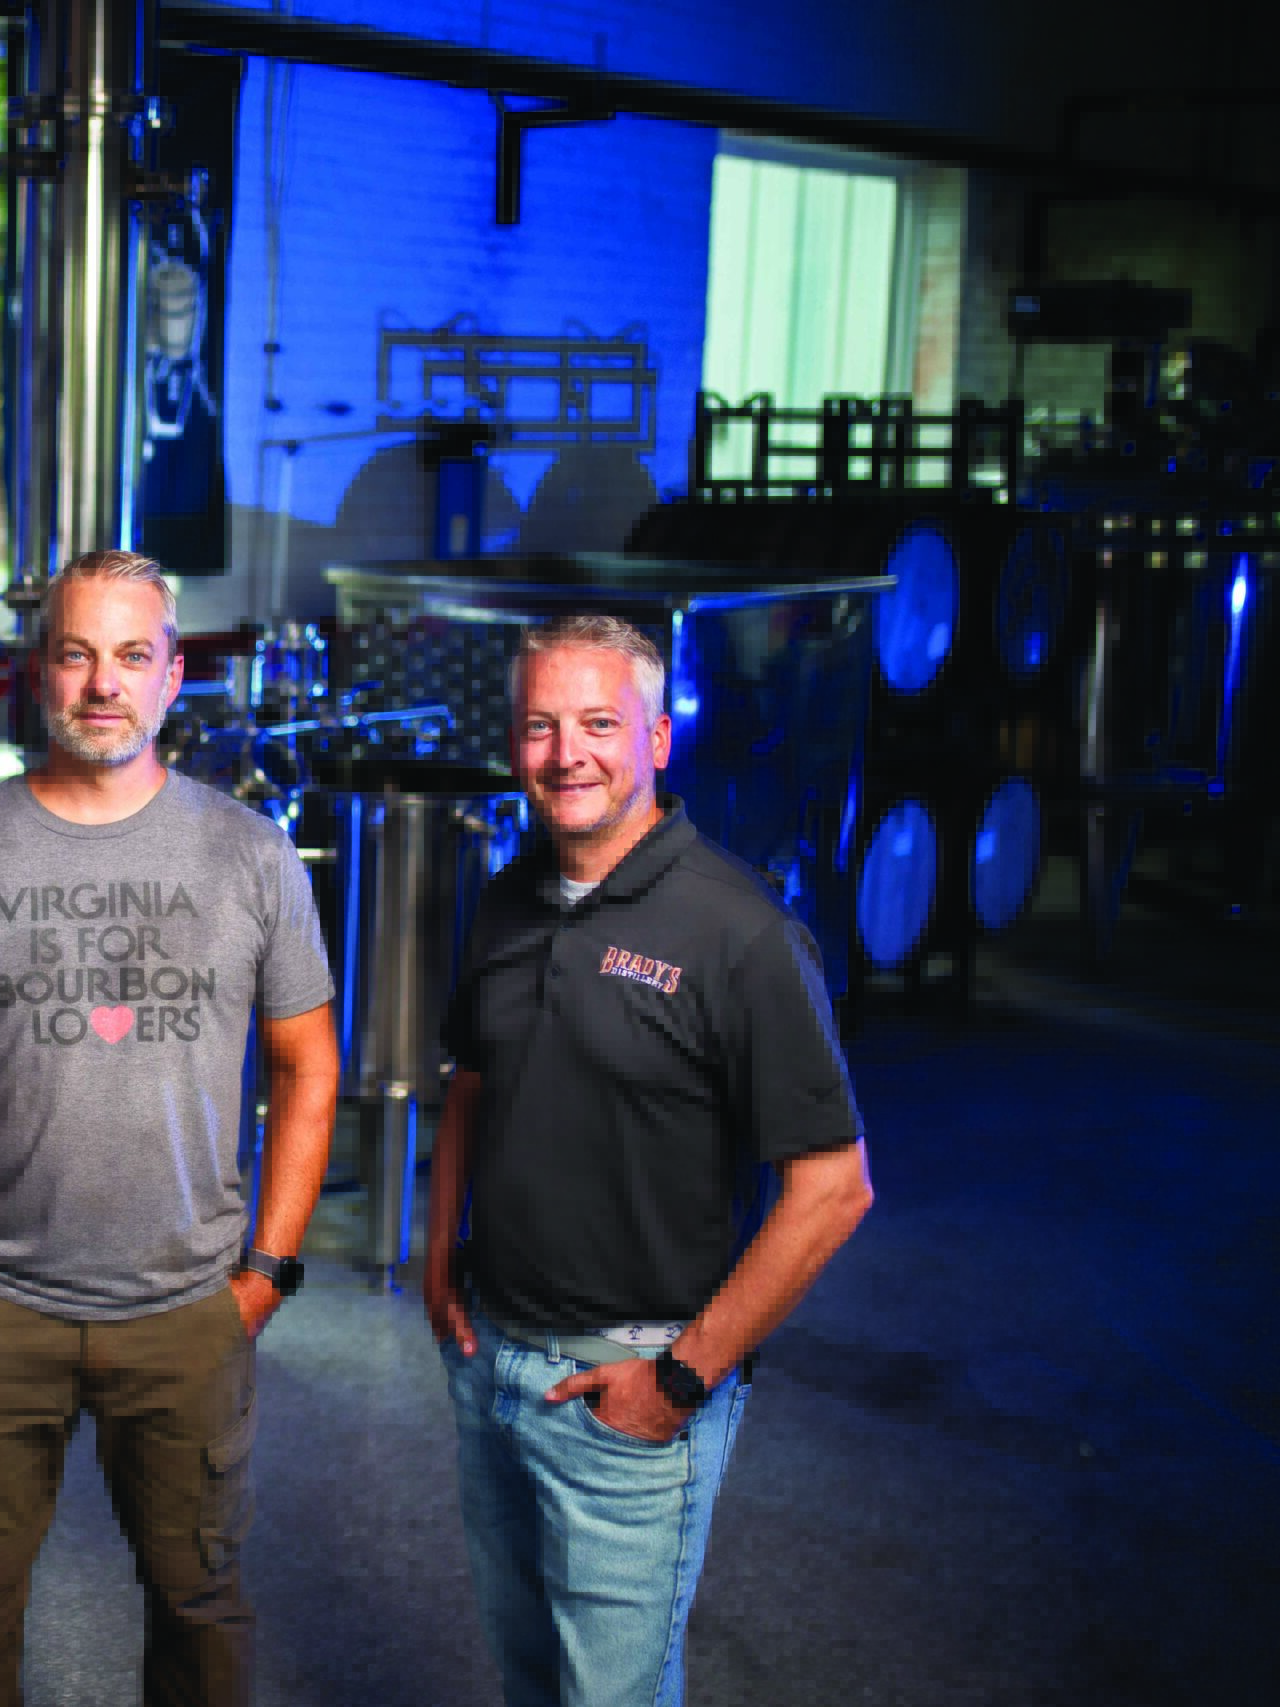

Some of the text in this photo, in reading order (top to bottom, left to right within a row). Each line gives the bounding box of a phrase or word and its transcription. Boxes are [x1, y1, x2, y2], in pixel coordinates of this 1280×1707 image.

[29, 925, 172, 964] IS FOR
[610, 967, 664, 989] DISTILLERY
[32, 1006, 201, 1045] LOERS
